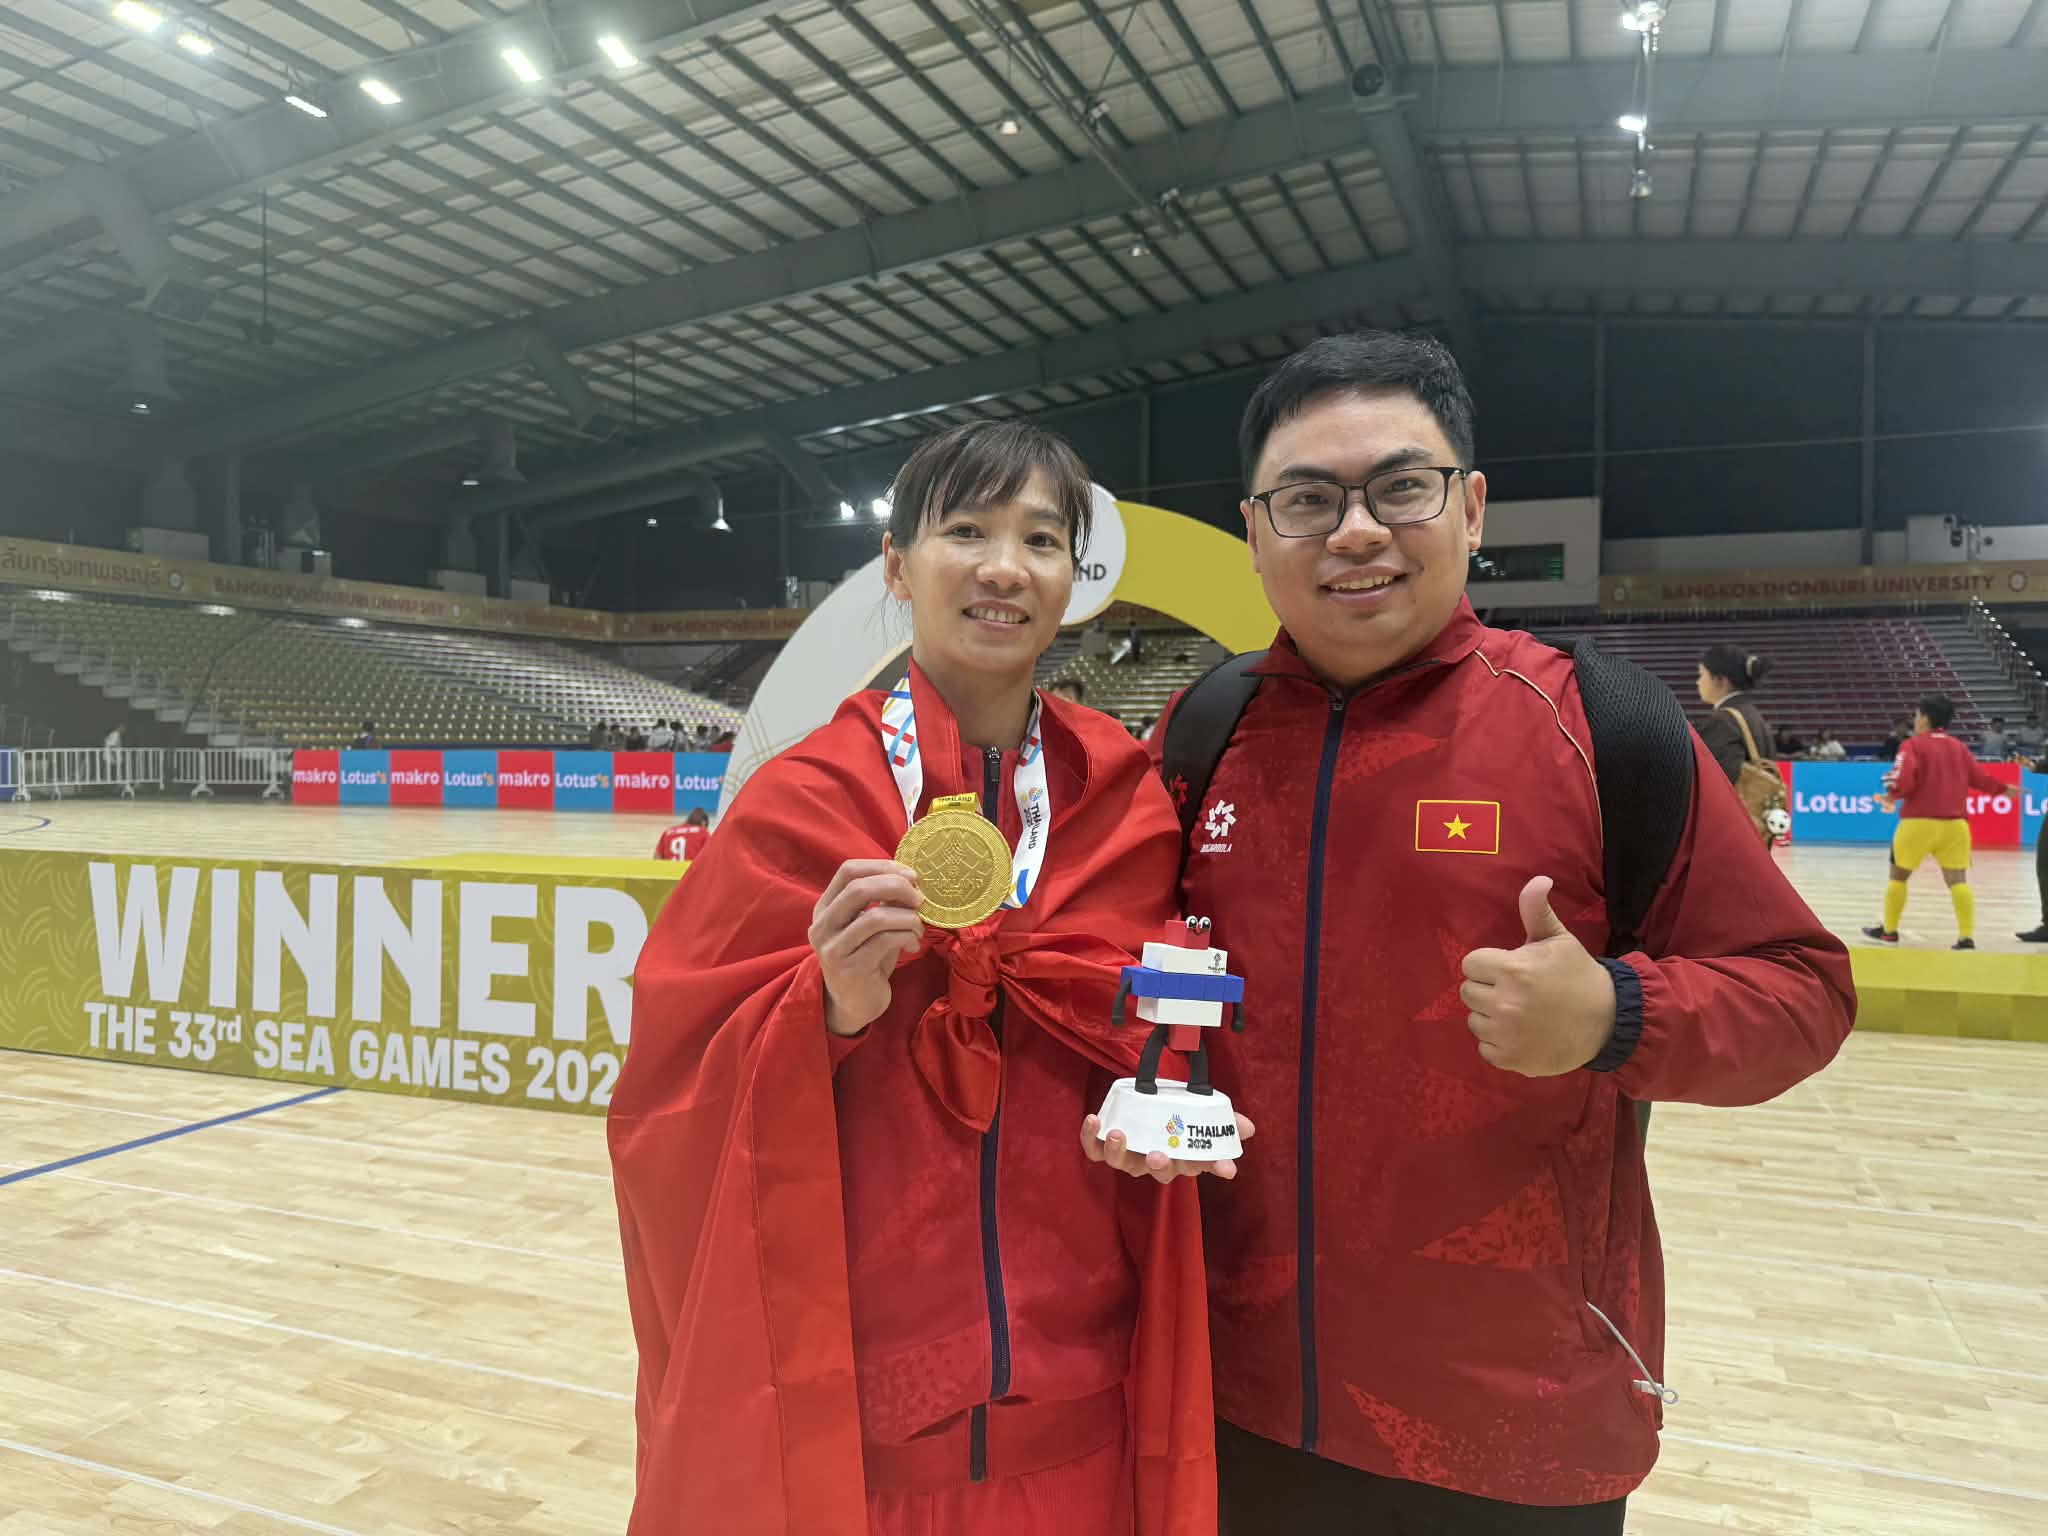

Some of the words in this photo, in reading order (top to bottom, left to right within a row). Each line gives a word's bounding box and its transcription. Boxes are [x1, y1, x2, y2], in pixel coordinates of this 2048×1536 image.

[1872, 574, 1996, 594] UNIVERSITY
[293, 767, 337, 784] makro
[341, 769, 387, 785] Lotus's
[391, 768, 440, 785] makro
[444, 771, 494, 787] Lotus's
[499, 769, 550, 787] makro
[556, 772, 609, 788] Lotus's
[614, 771, 670, 789] makro
[670, 835, 686, 862] 9
[88, 861, 649, 1046] WINNER
[84, 1001, 157, 1055] THE
[168, 1010, 242, 1062] 33rd
[253, 1019, 335, 1076] SEA
[350, 1029, 510, 1095] GAMES
[1186, 1124, 1236, 1138] THAILAND
[1187, 1138, 1213, 1150] 2025
